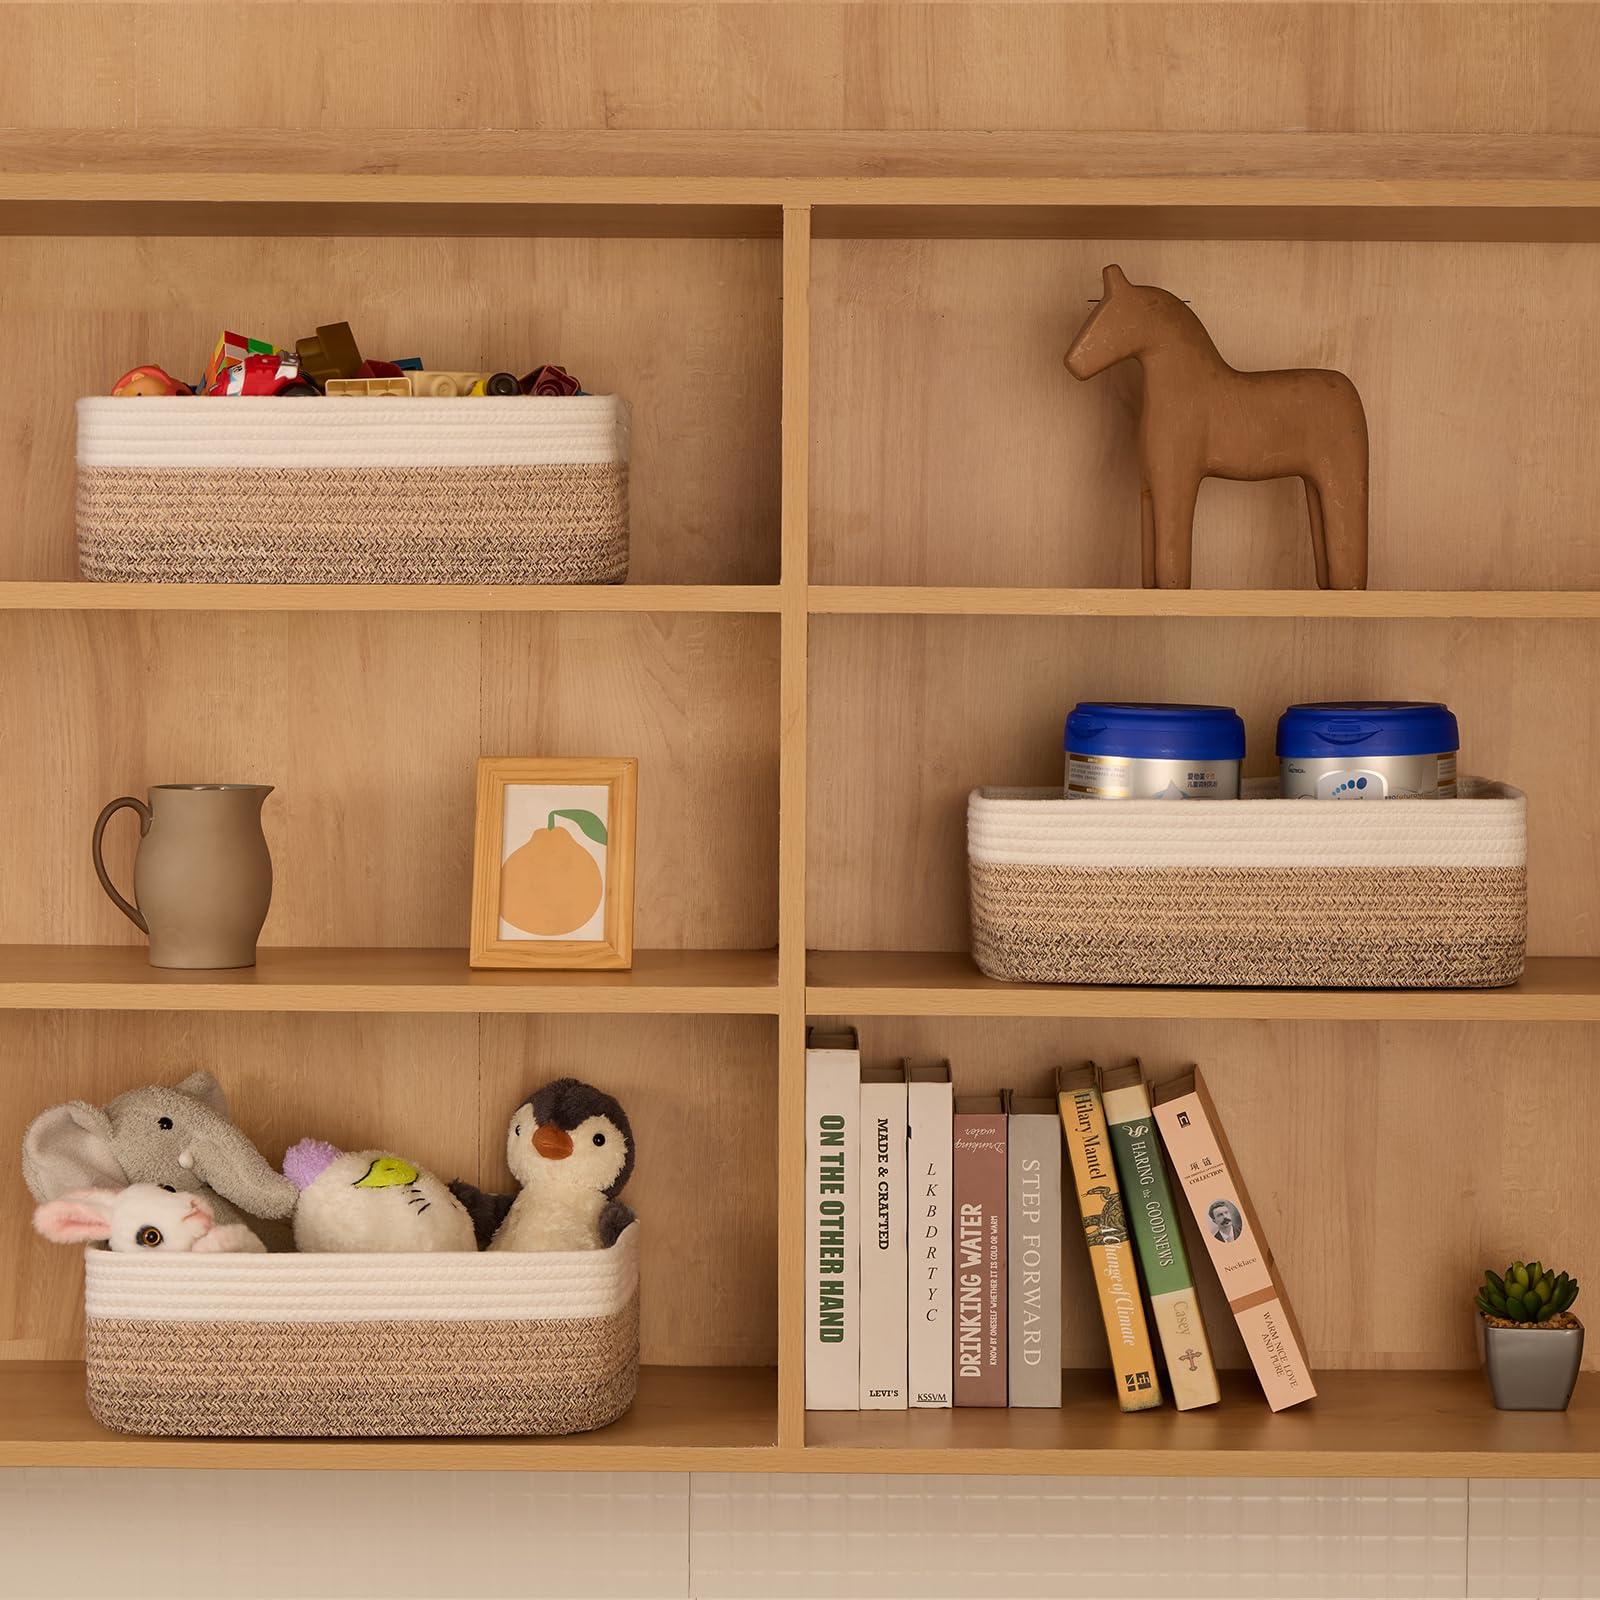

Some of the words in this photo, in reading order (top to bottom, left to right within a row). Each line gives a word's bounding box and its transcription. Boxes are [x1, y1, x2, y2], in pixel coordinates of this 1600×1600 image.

[1074, 1092, 1094, 1133] Hilary
[819, 1115, 845, 1146] ON
[877, 1118, 889, 1163] MADE
[954, 1139, 1006, 1153] Drinking
[964, 1127, 996, 1138] water
[819, 1152, 845, 1194] THE
[877, 1166, 889, 1178] &
[1083, 1134, 1107, 1180] Mantel
[1022, 1159, 1041, 1223] STEP
[1189, 1168, 1224, 1185] COLLECTION
[878, 1181, 889, 1250] CRAFTED
[990, 1215, 998, 1234] WARM
[1145, 1201, 1167, 1234] GOOD
[819, 1201, 845, 1274] OTHER
[960, 1203, 982, 1269] WATER
[990, 1235, 998, 1244] OR
[1153, 1234, 1174, 1267] NEWS
[990, 1245, 998, 1260] COLD
[990, 1261, 998, 1269] IS
[1103, 1235, 1122, 1282] Change
[1224, 1257, 1257, 1273] Necklace
[989, 1269, 998, 1278] IT
[989, 1279, 998, 1308] WHETHER
[1022, 1233, 1042, 1366] FORWARD
[1108, 1283, 1131, 1298] of
[819, 1281, 845, 1343] HAND
[959, 1274, 982, 1377] DRINKING
[989, 1310, 998, 1336] ONESELF
[1115, 1297, 1136, 1346] Climate
[1172, 1300, 1191, 1335] Casey
[989, 1337, 998, 1345] BY
[989, 1346, 998, 1366] KNOW
[1261, 1333, 1275, 1353] AND
[1270, 1354, 1285, 1378] PURE
[1263, 1311, 1280, 1340] WARM
[1275, 1341, 1289, 1366] NICE
[1283, 1363, 1299, 1388] LOVE
[869, 1390, 899, 1398] LEVI'S
[916, 1393, 947, 1402] KSSVM
